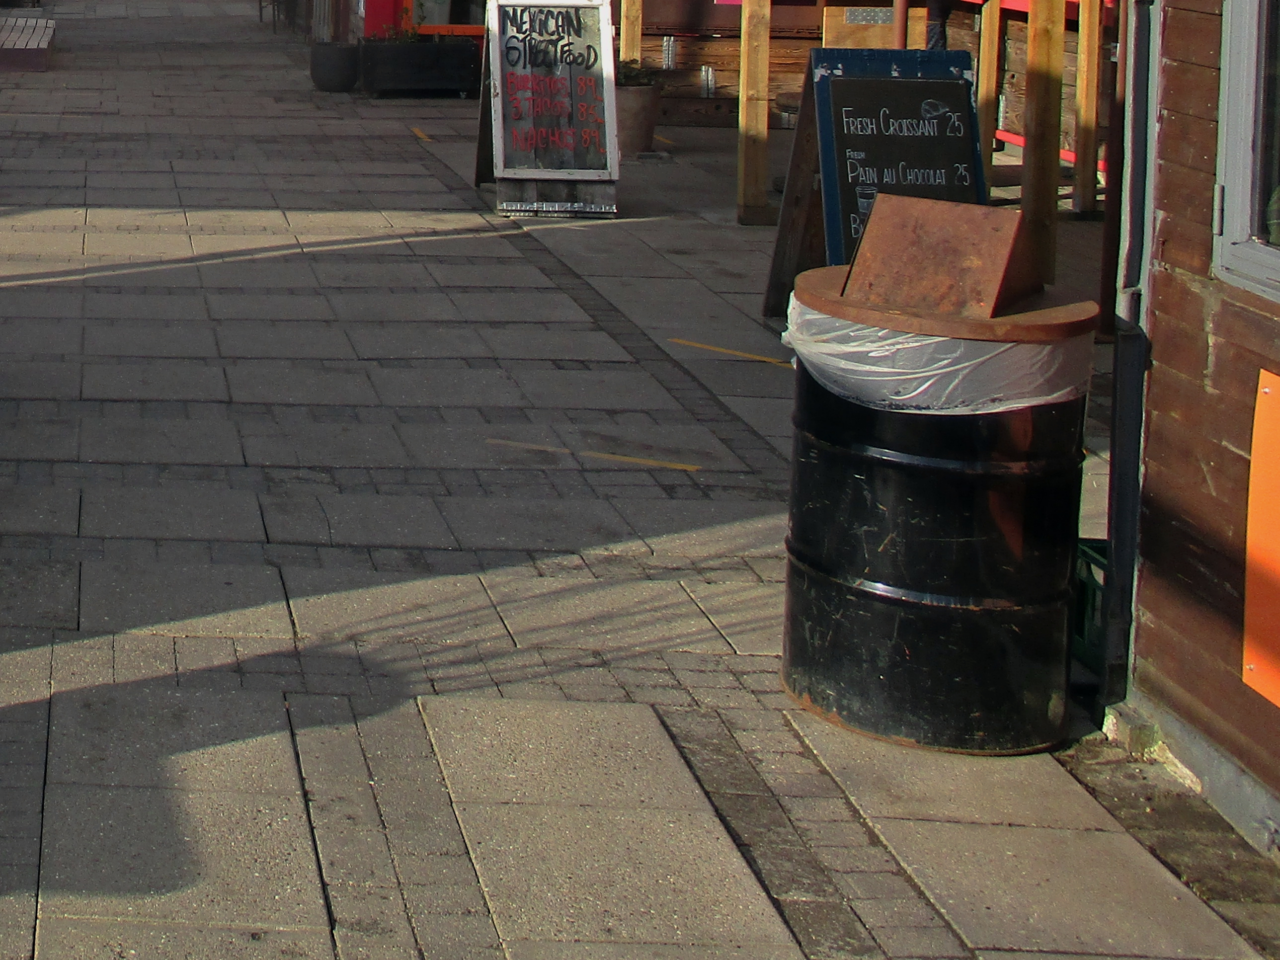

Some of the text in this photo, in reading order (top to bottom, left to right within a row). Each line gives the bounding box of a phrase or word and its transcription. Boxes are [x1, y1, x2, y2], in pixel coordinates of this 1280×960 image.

[509, 96, 523, 120] 3
[525, 96, 571, 119] TACOS
[946, 112, 964, 137] 25
[511, 127, 577, 153] NACHOS
[954, 163, 970, 186] 25
